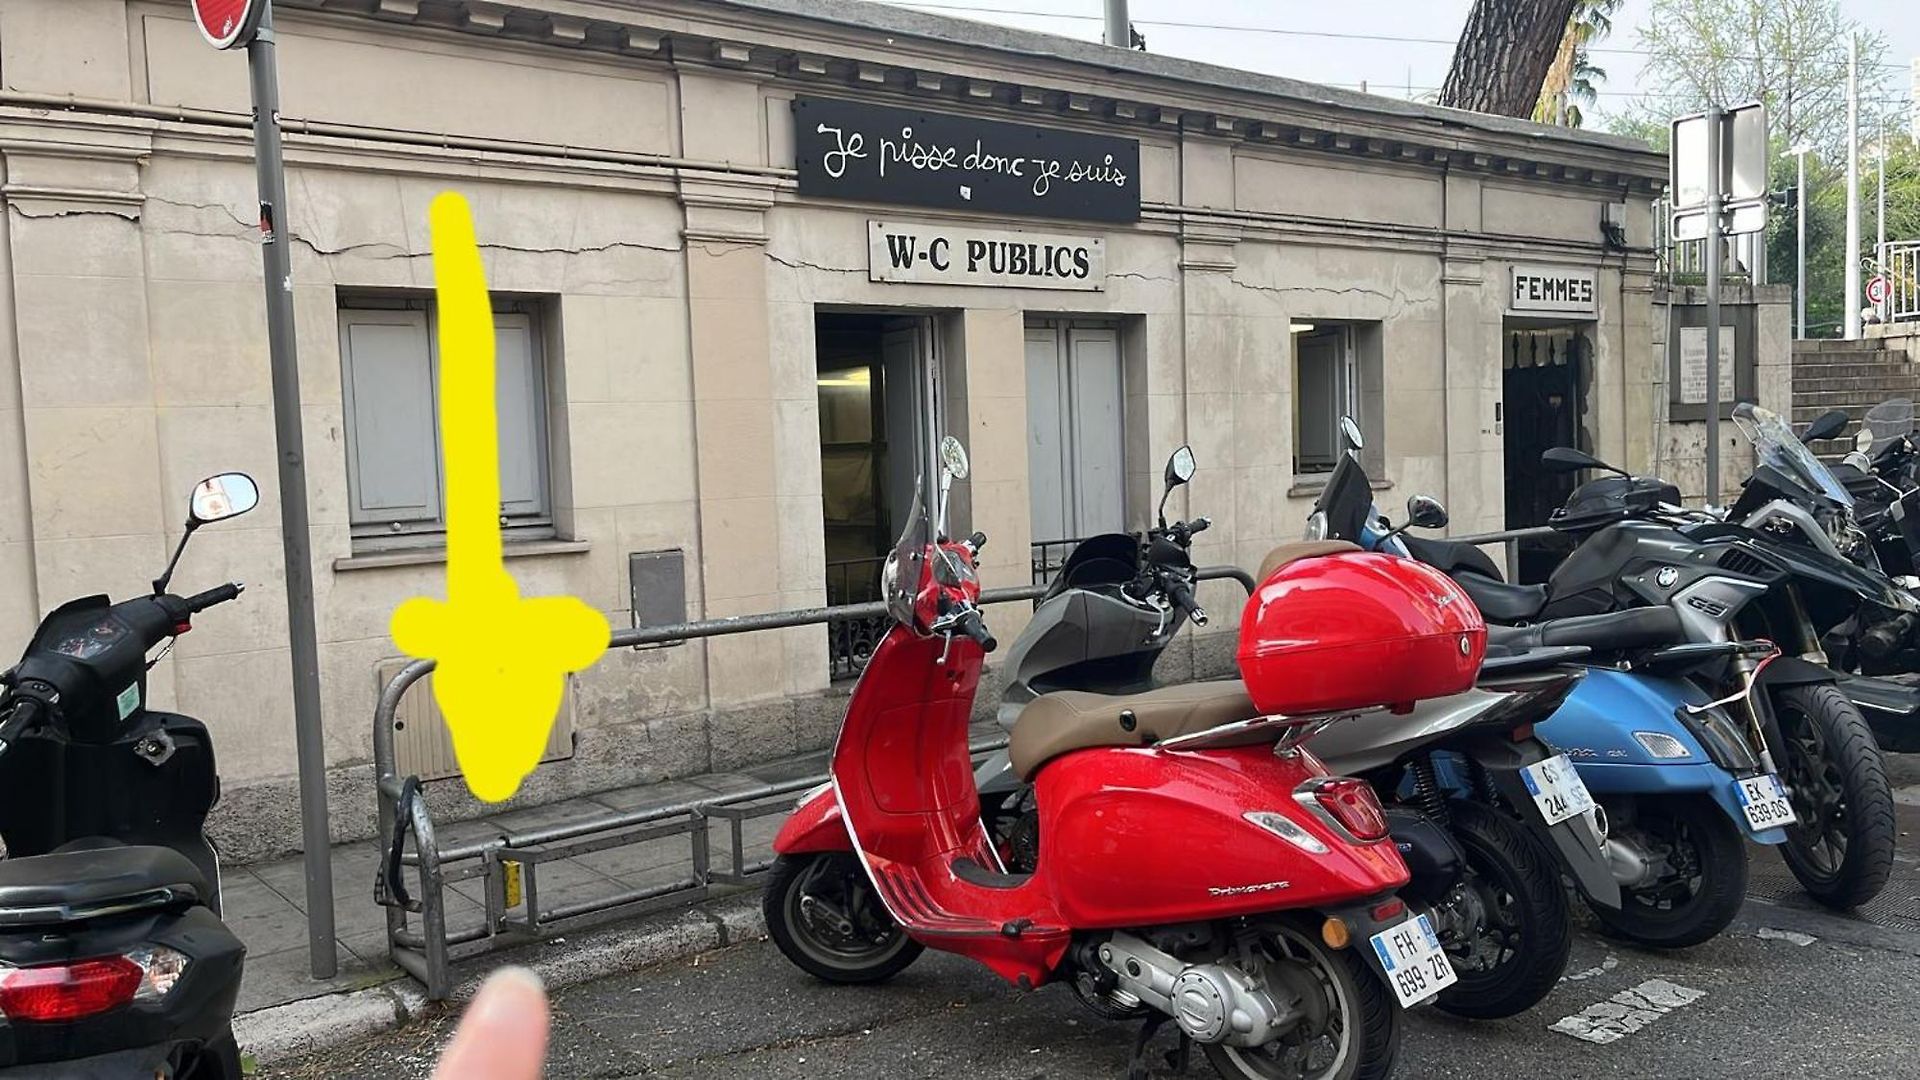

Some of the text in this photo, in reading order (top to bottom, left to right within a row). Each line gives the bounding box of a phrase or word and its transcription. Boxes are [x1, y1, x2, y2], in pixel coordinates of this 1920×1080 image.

[817, 123, 868, 178] Je
[879, 126, 958, 177] pisse
[963, 139, 1025, 176] donc
[1064, 154, 1127, 187] suis
[886, 234, 1090, 279] W-C PUBLICS
[1516, 275, 1592, 303] FEMMES
[1688, 596, 1728, 617] GS
[1745, 782, 1766, 802] EK
